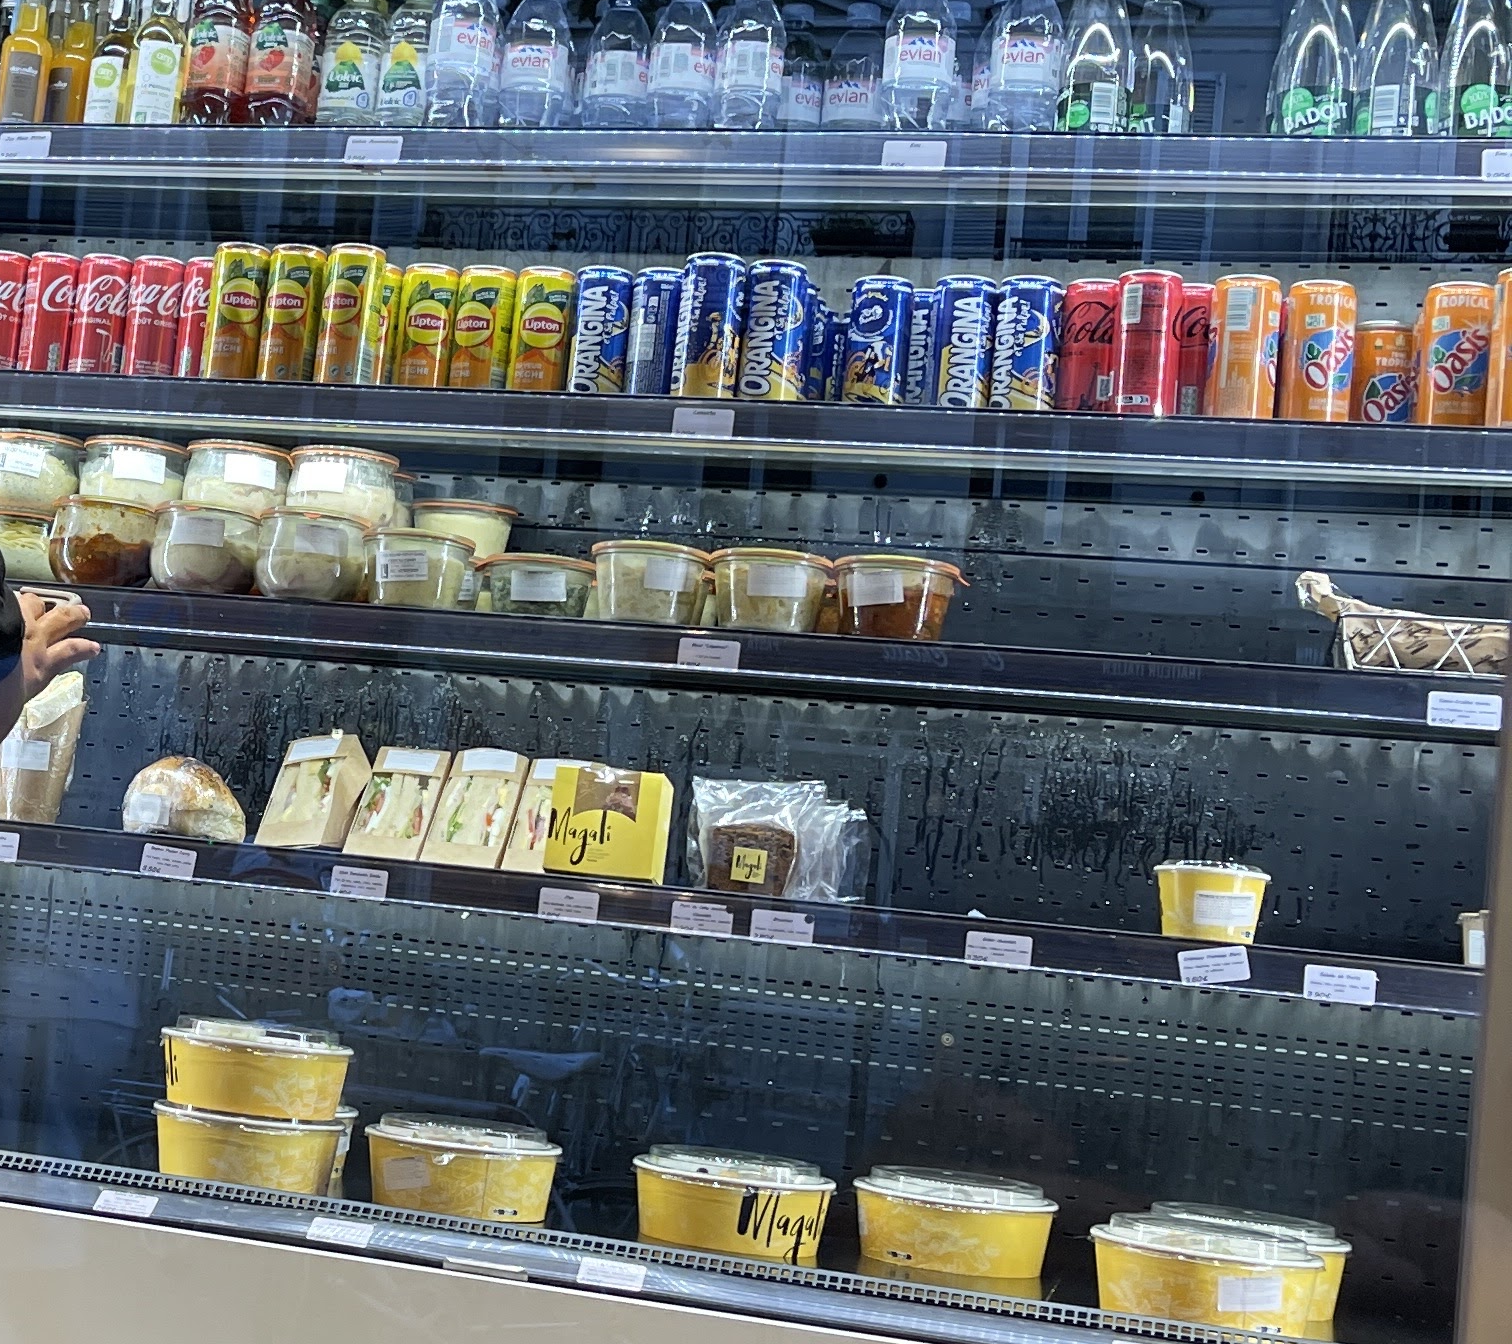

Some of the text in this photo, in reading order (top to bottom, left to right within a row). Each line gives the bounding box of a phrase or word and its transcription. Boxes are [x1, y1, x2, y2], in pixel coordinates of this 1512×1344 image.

[511, 53, 551, 69] evian
[899, 47, 943, 63] evian
[1001, 48, 1045, 64] evian
[828, 90, 869, 105] evian
[1282, 101, 1349, 135] BADOIT
[224, 293, 257, 307] Lipton
[1436, 295, 1490, 310] TROPICAL
[410, 316, 444, 328] Lipton
[456, 318, 488, 329] Lipton
[525, 319, 560, 332] Lipton
[572, 285, 610, 394] ORANGINA
[739, 279, 781, 397] ORANGINA
[938, 296, 983, 409] ORANGINA
[989, 296, 1019, 409] ORANGINA
[1303, 326, 1356, 391] Oasis
[1432, 328, 1490, 394] Oasis
[548, 807, 612, 866] Magali
[734, 853, 763, 879] Magali
